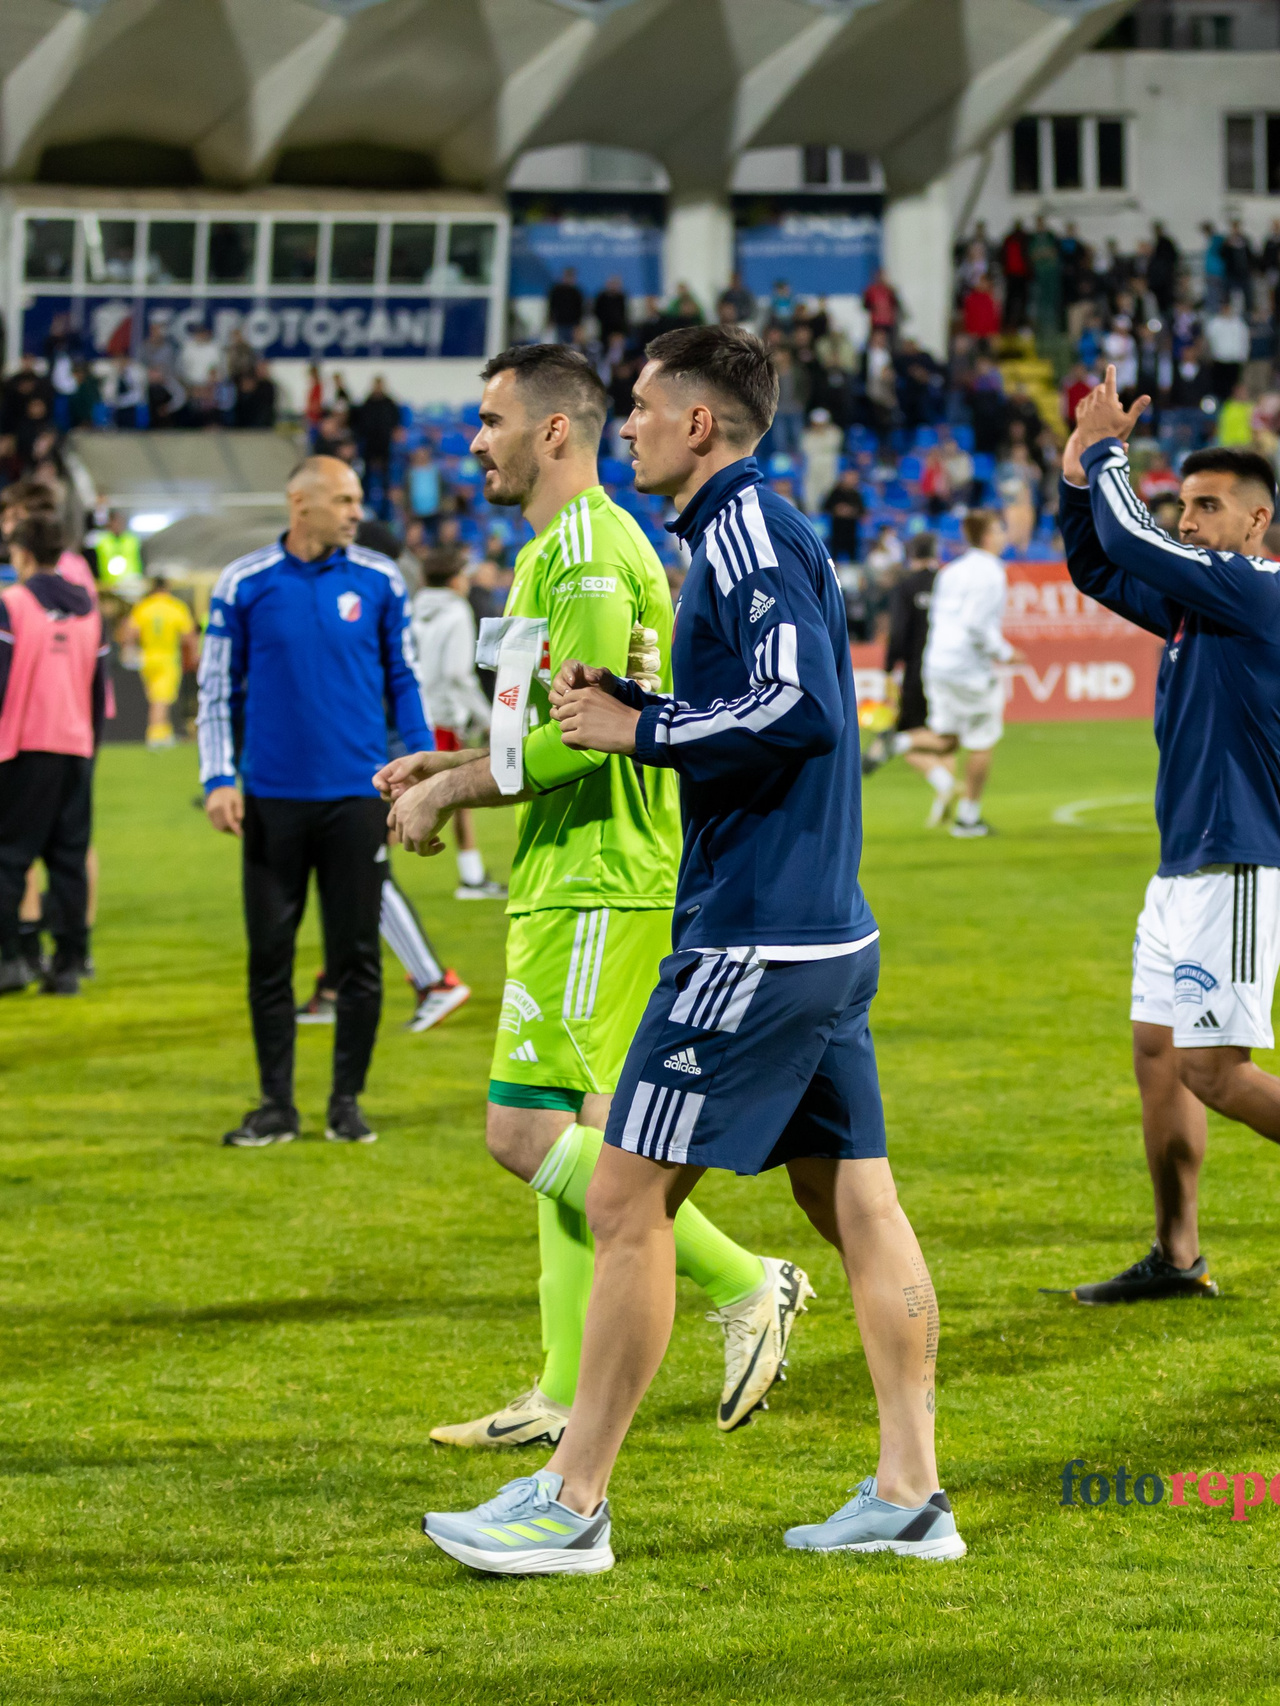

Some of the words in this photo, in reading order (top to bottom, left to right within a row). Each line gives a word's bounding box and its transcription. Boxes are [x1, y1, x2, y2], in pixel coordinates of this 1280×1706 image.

[750, 597, 776, 623] adidas
[1066, 661, 1135, 702] HD
[663, 1059, 702, 1075] adidas
